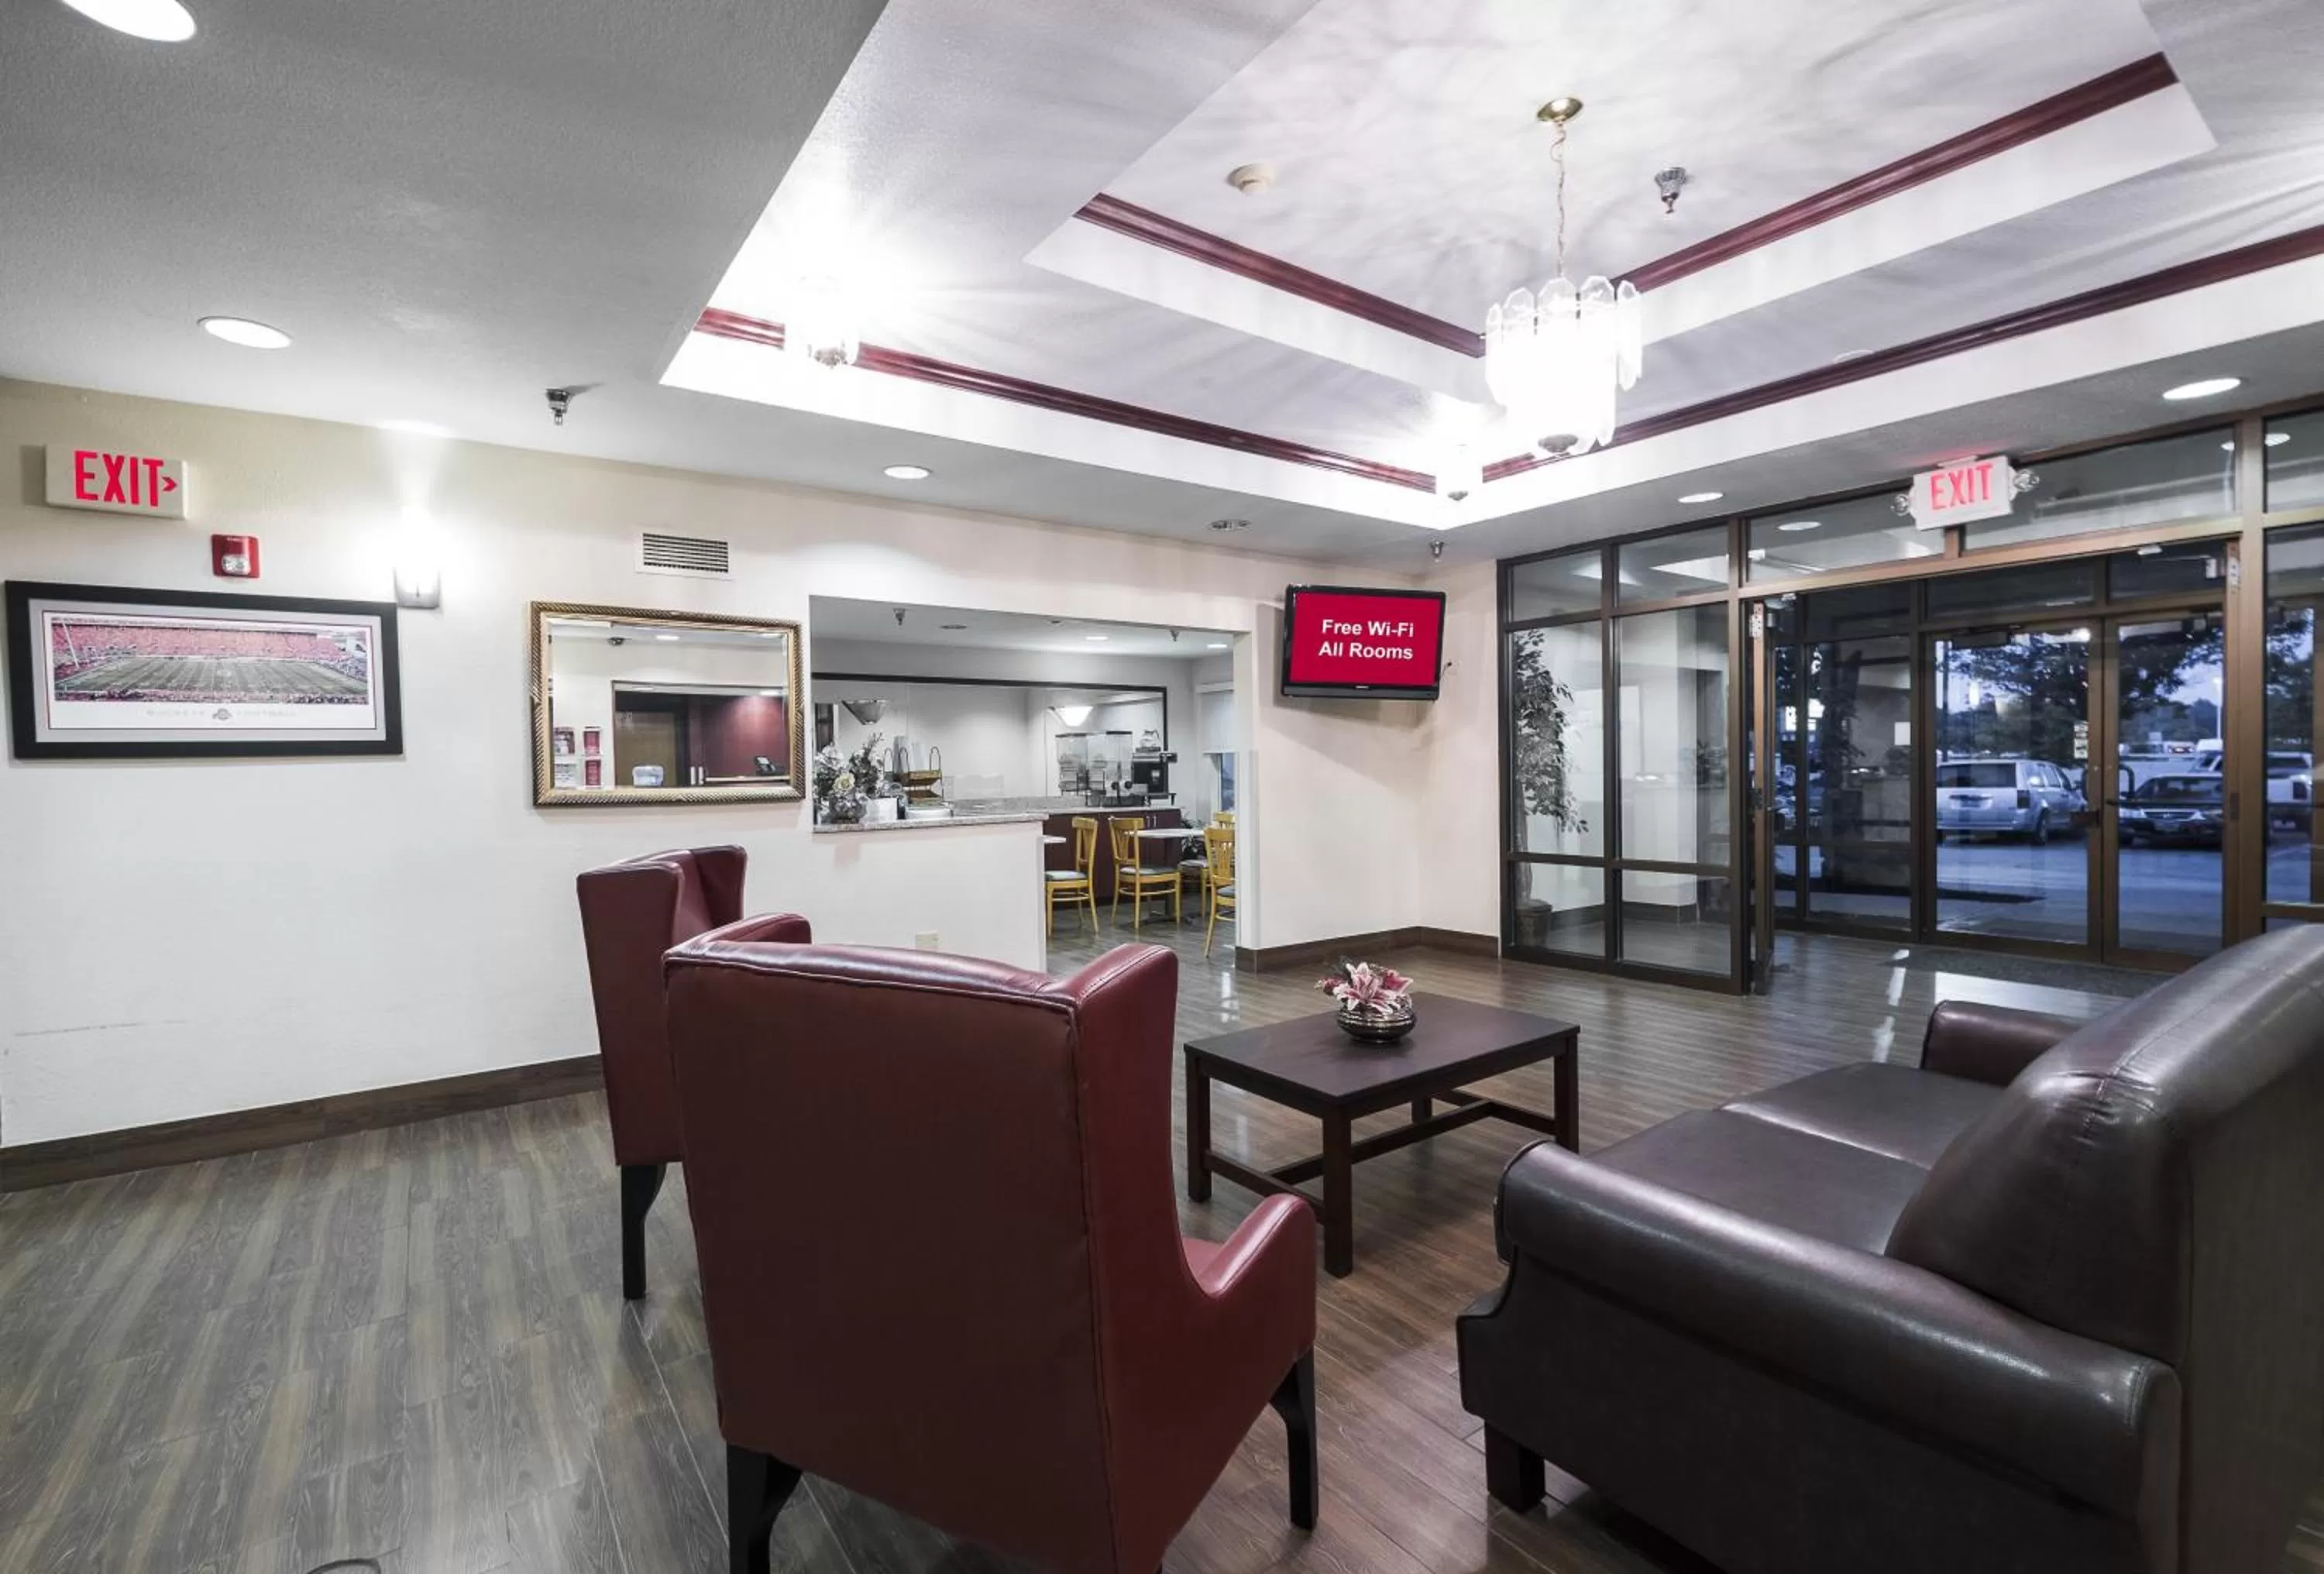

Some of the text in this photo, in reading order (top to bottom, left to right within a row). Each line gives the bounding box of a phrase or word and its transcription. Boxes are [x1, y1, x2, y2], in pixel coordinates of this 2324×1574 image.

[74, 450, 164, 507] EXIT
[1930, 462, 1992, 510] EXIT
[1322, 619, 1414, 638] Free Wi-Fi
[1318, 641, 1414, 659] All Rooms
